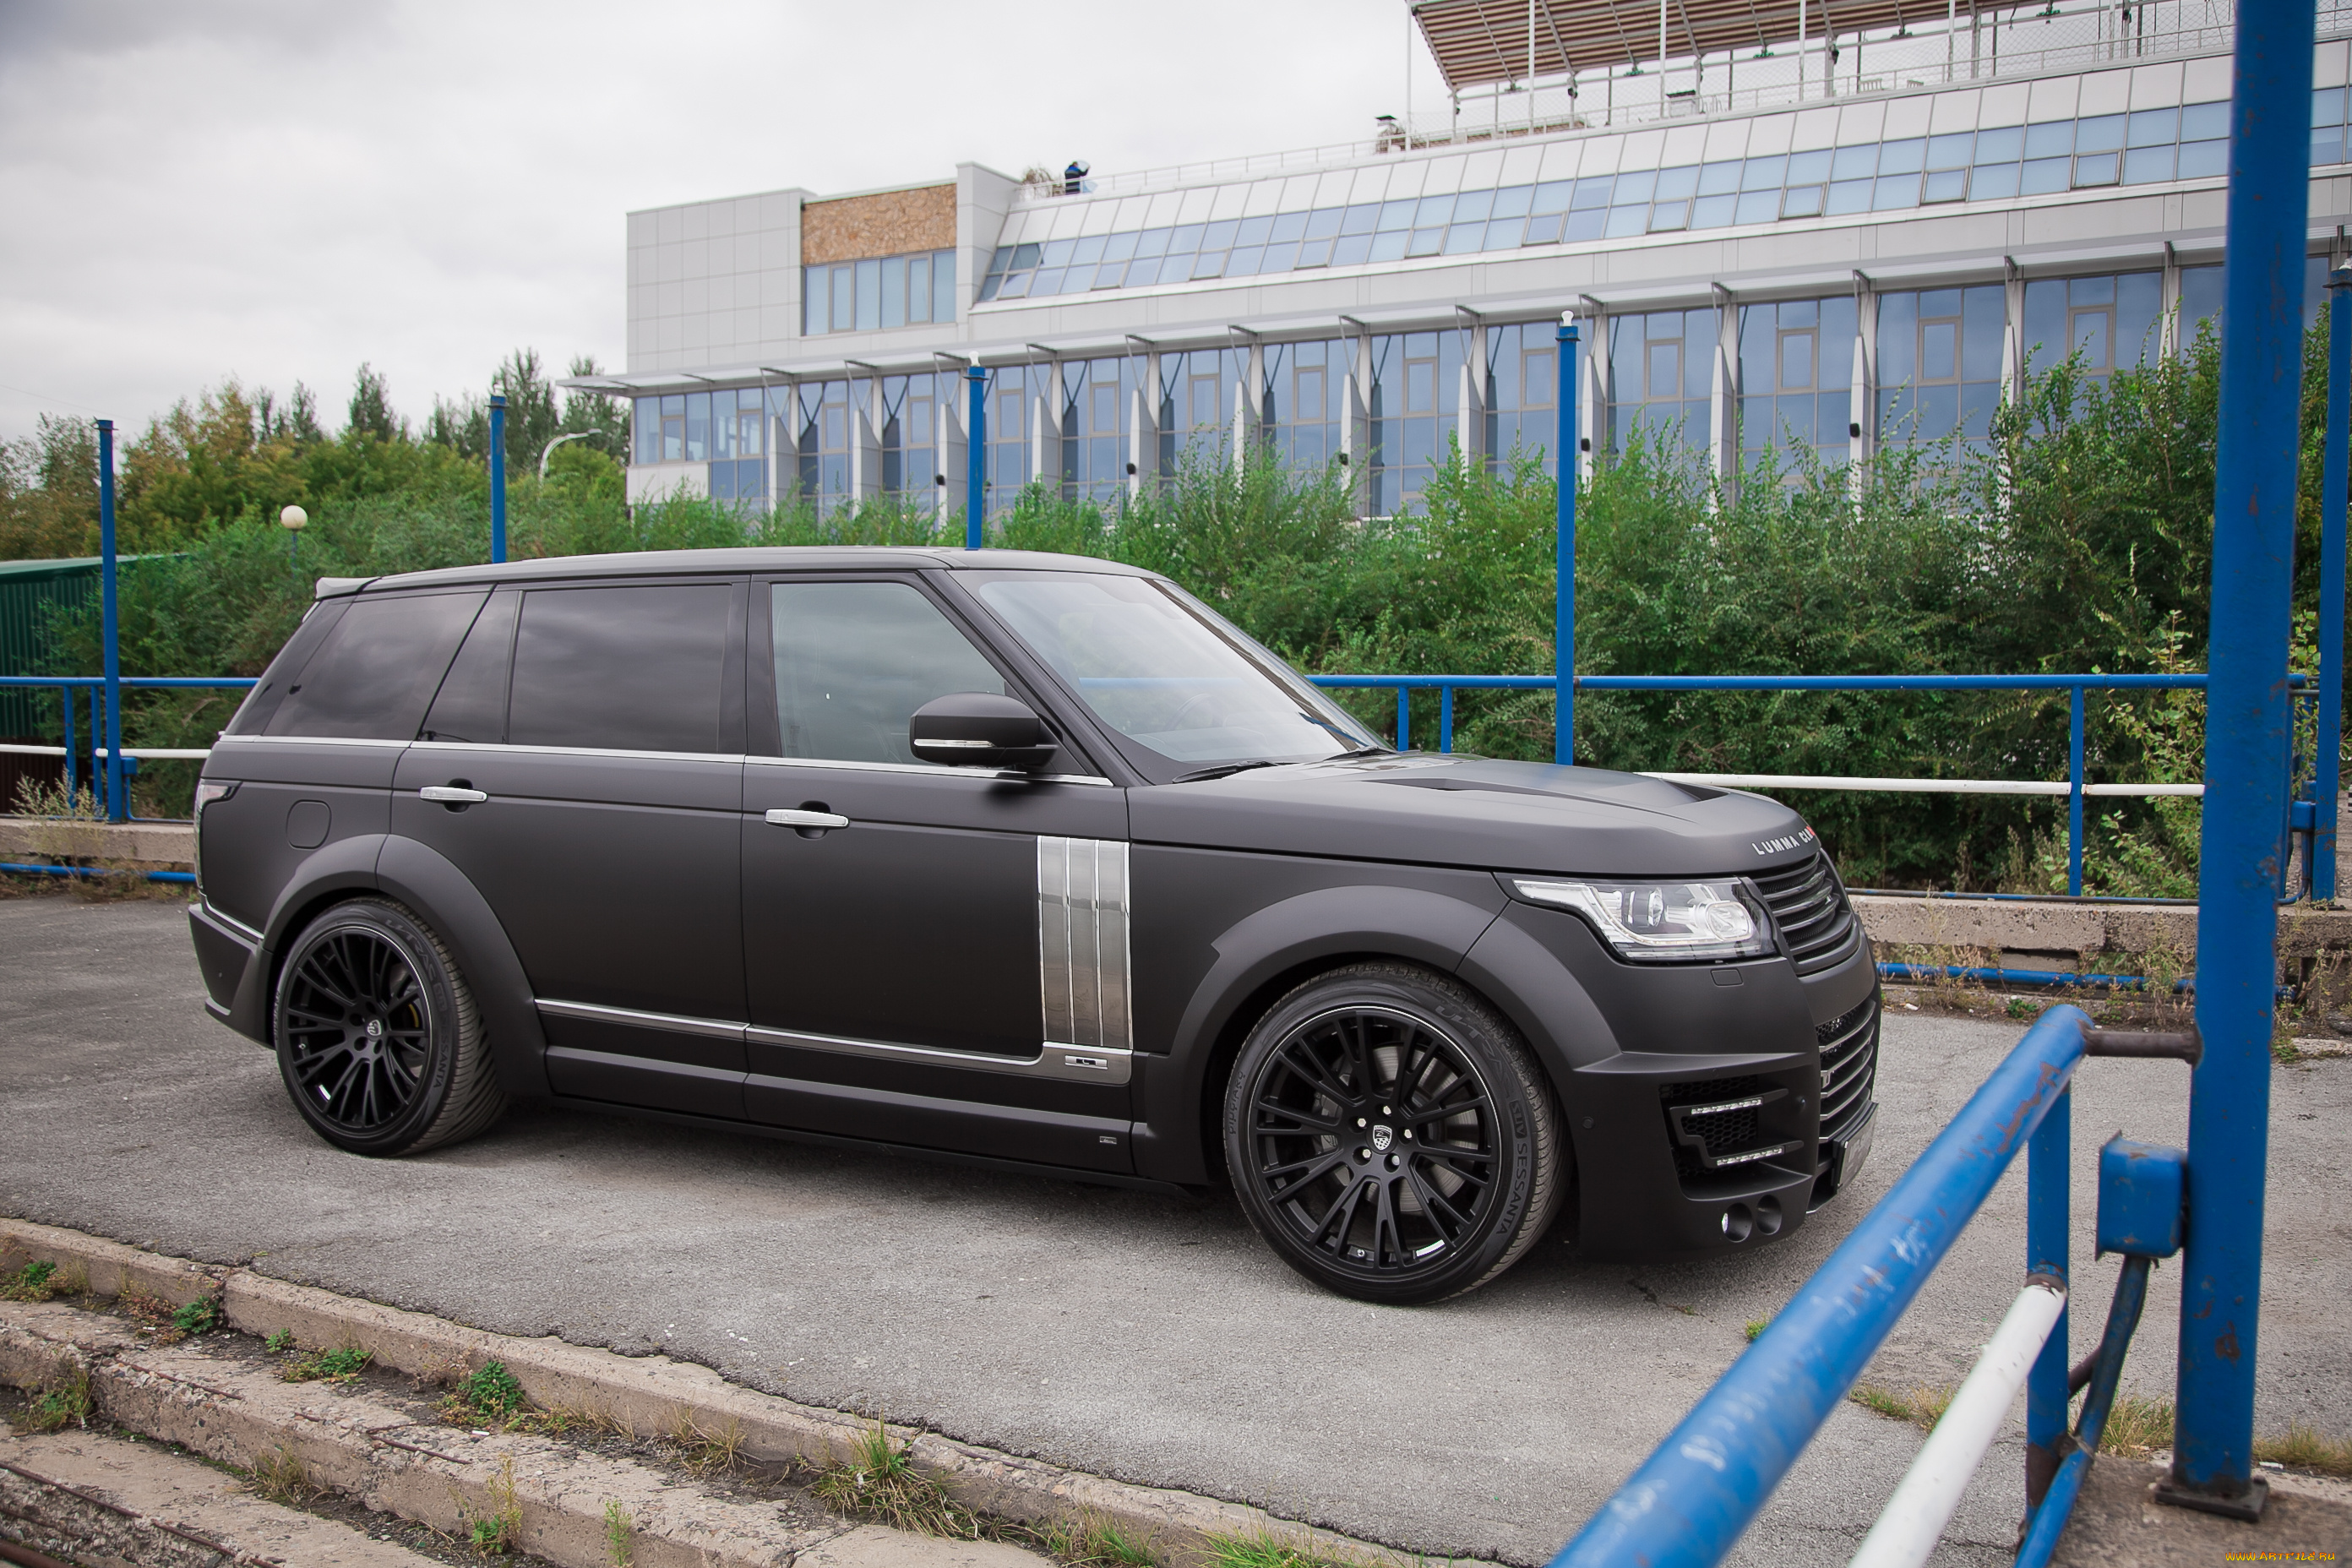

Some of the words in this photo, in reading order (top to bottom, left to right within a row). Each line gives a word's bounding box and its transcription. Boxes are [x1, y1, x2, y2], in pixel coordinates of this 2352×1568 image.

[1751, 835, 1800, 855] LUMMA
[1511, 1101, 1526, 1137] SUV
[1496, 1142, 1527, 1234] SESSANTA
